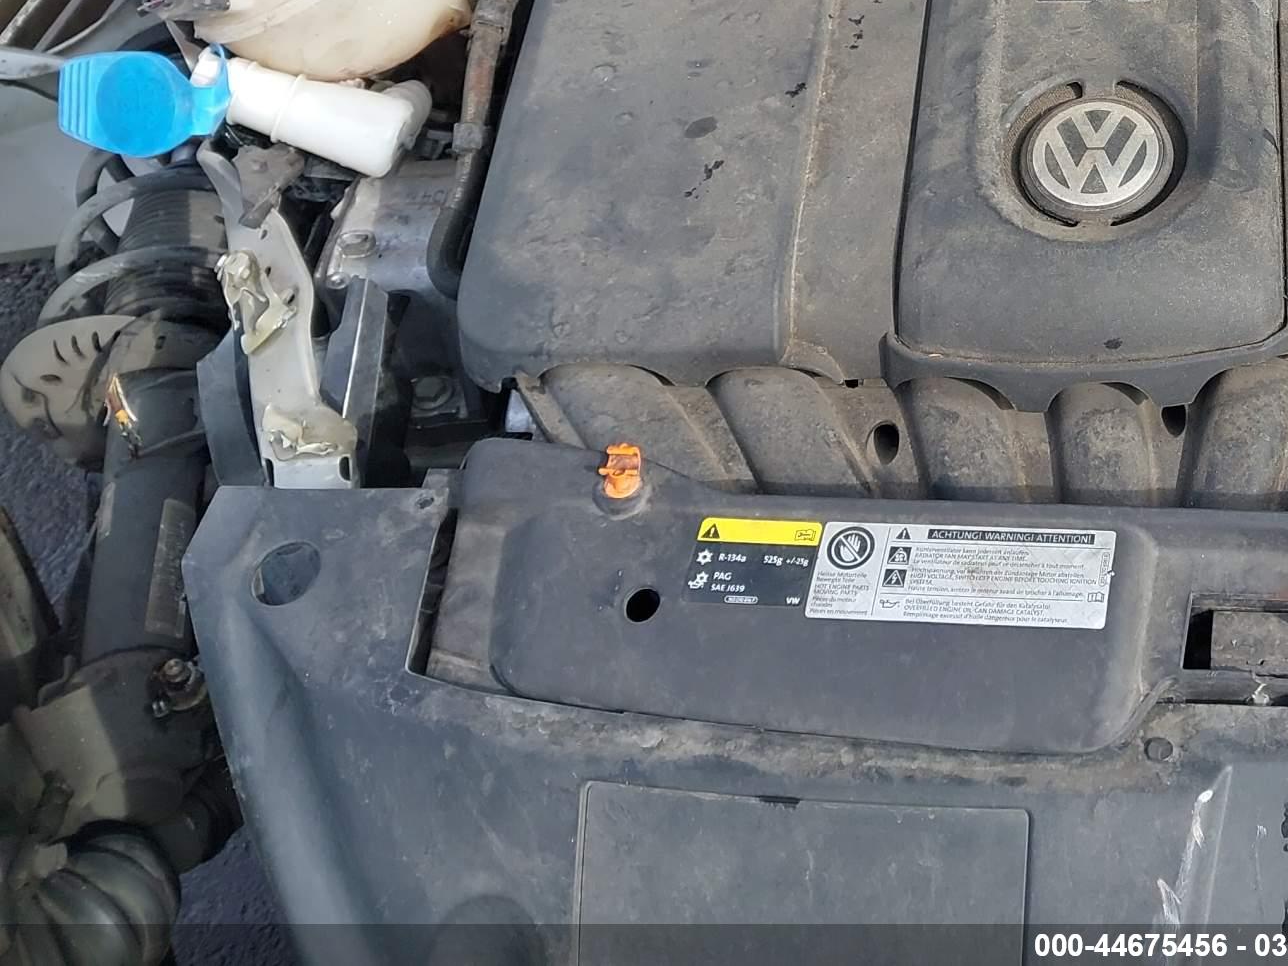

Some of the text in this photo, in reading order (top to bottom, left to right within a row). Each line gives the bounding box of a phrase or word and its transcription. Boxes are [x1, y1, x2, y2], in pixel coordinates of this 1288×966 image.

[932, 530, 1092, 544] ACHTUNG! WARNING! ATTENTION!
[718, 553, 747, 563] R-134a
[763, 555, 783, 567] 525g
[713, 572, 732, 580] PAG
[711, 584, 745, 593] SAE J639
[786, 597, 801, 605] VW
